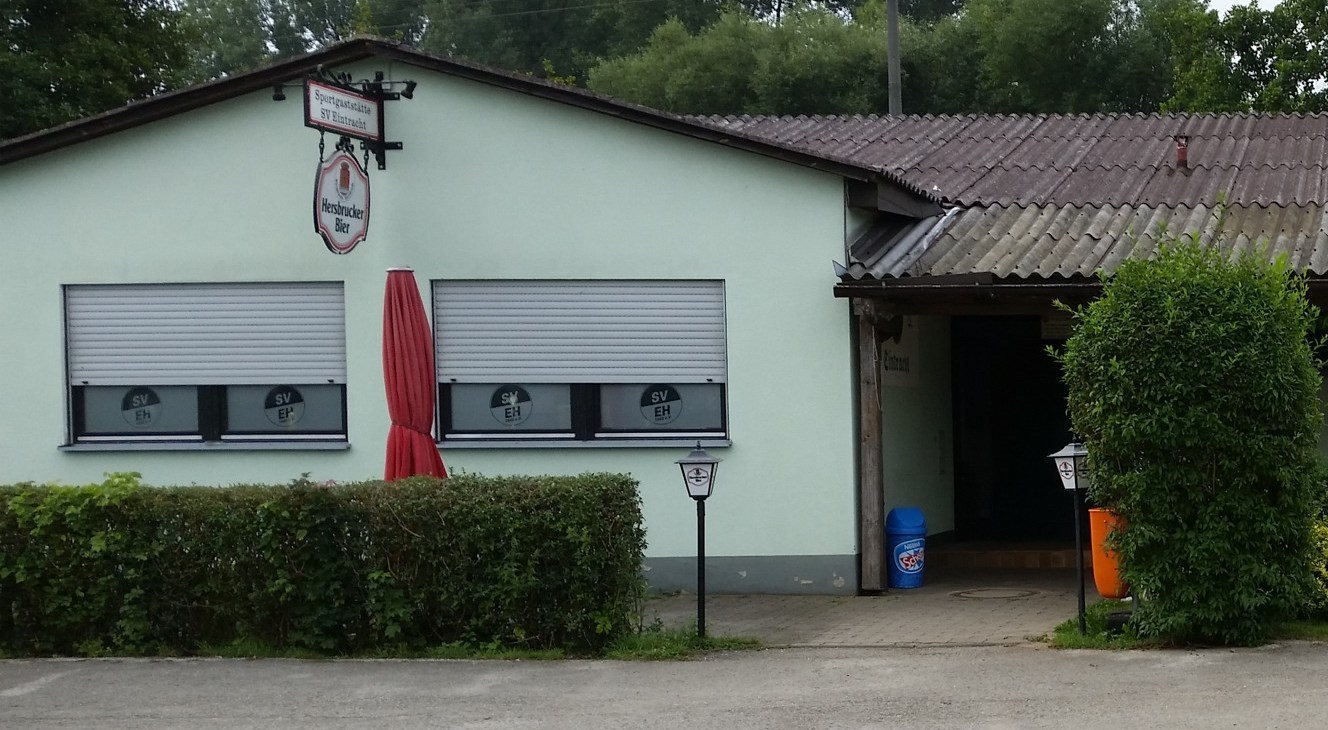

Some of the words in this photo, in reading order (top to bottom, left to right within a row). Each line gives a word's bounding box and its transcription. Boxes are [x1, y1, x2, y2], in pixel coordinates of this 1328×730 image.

[314, 89, 371, 115] Sportgaststätte
[320, 108, 331, 120] SV
[332, 110, 367, 130] Eintracht
[321, 198, 364, 220] Hersbrucker
[335, 217, 350, 234] Bier
[132, 394, 149, 407] SV
[275, 392, 291, 405] SV
[651, 389, 668, 403] SV
[278, 406, 294, 420] EH
[504, 406, 520, 418] EH
[654, 404, 670, 417] EH
